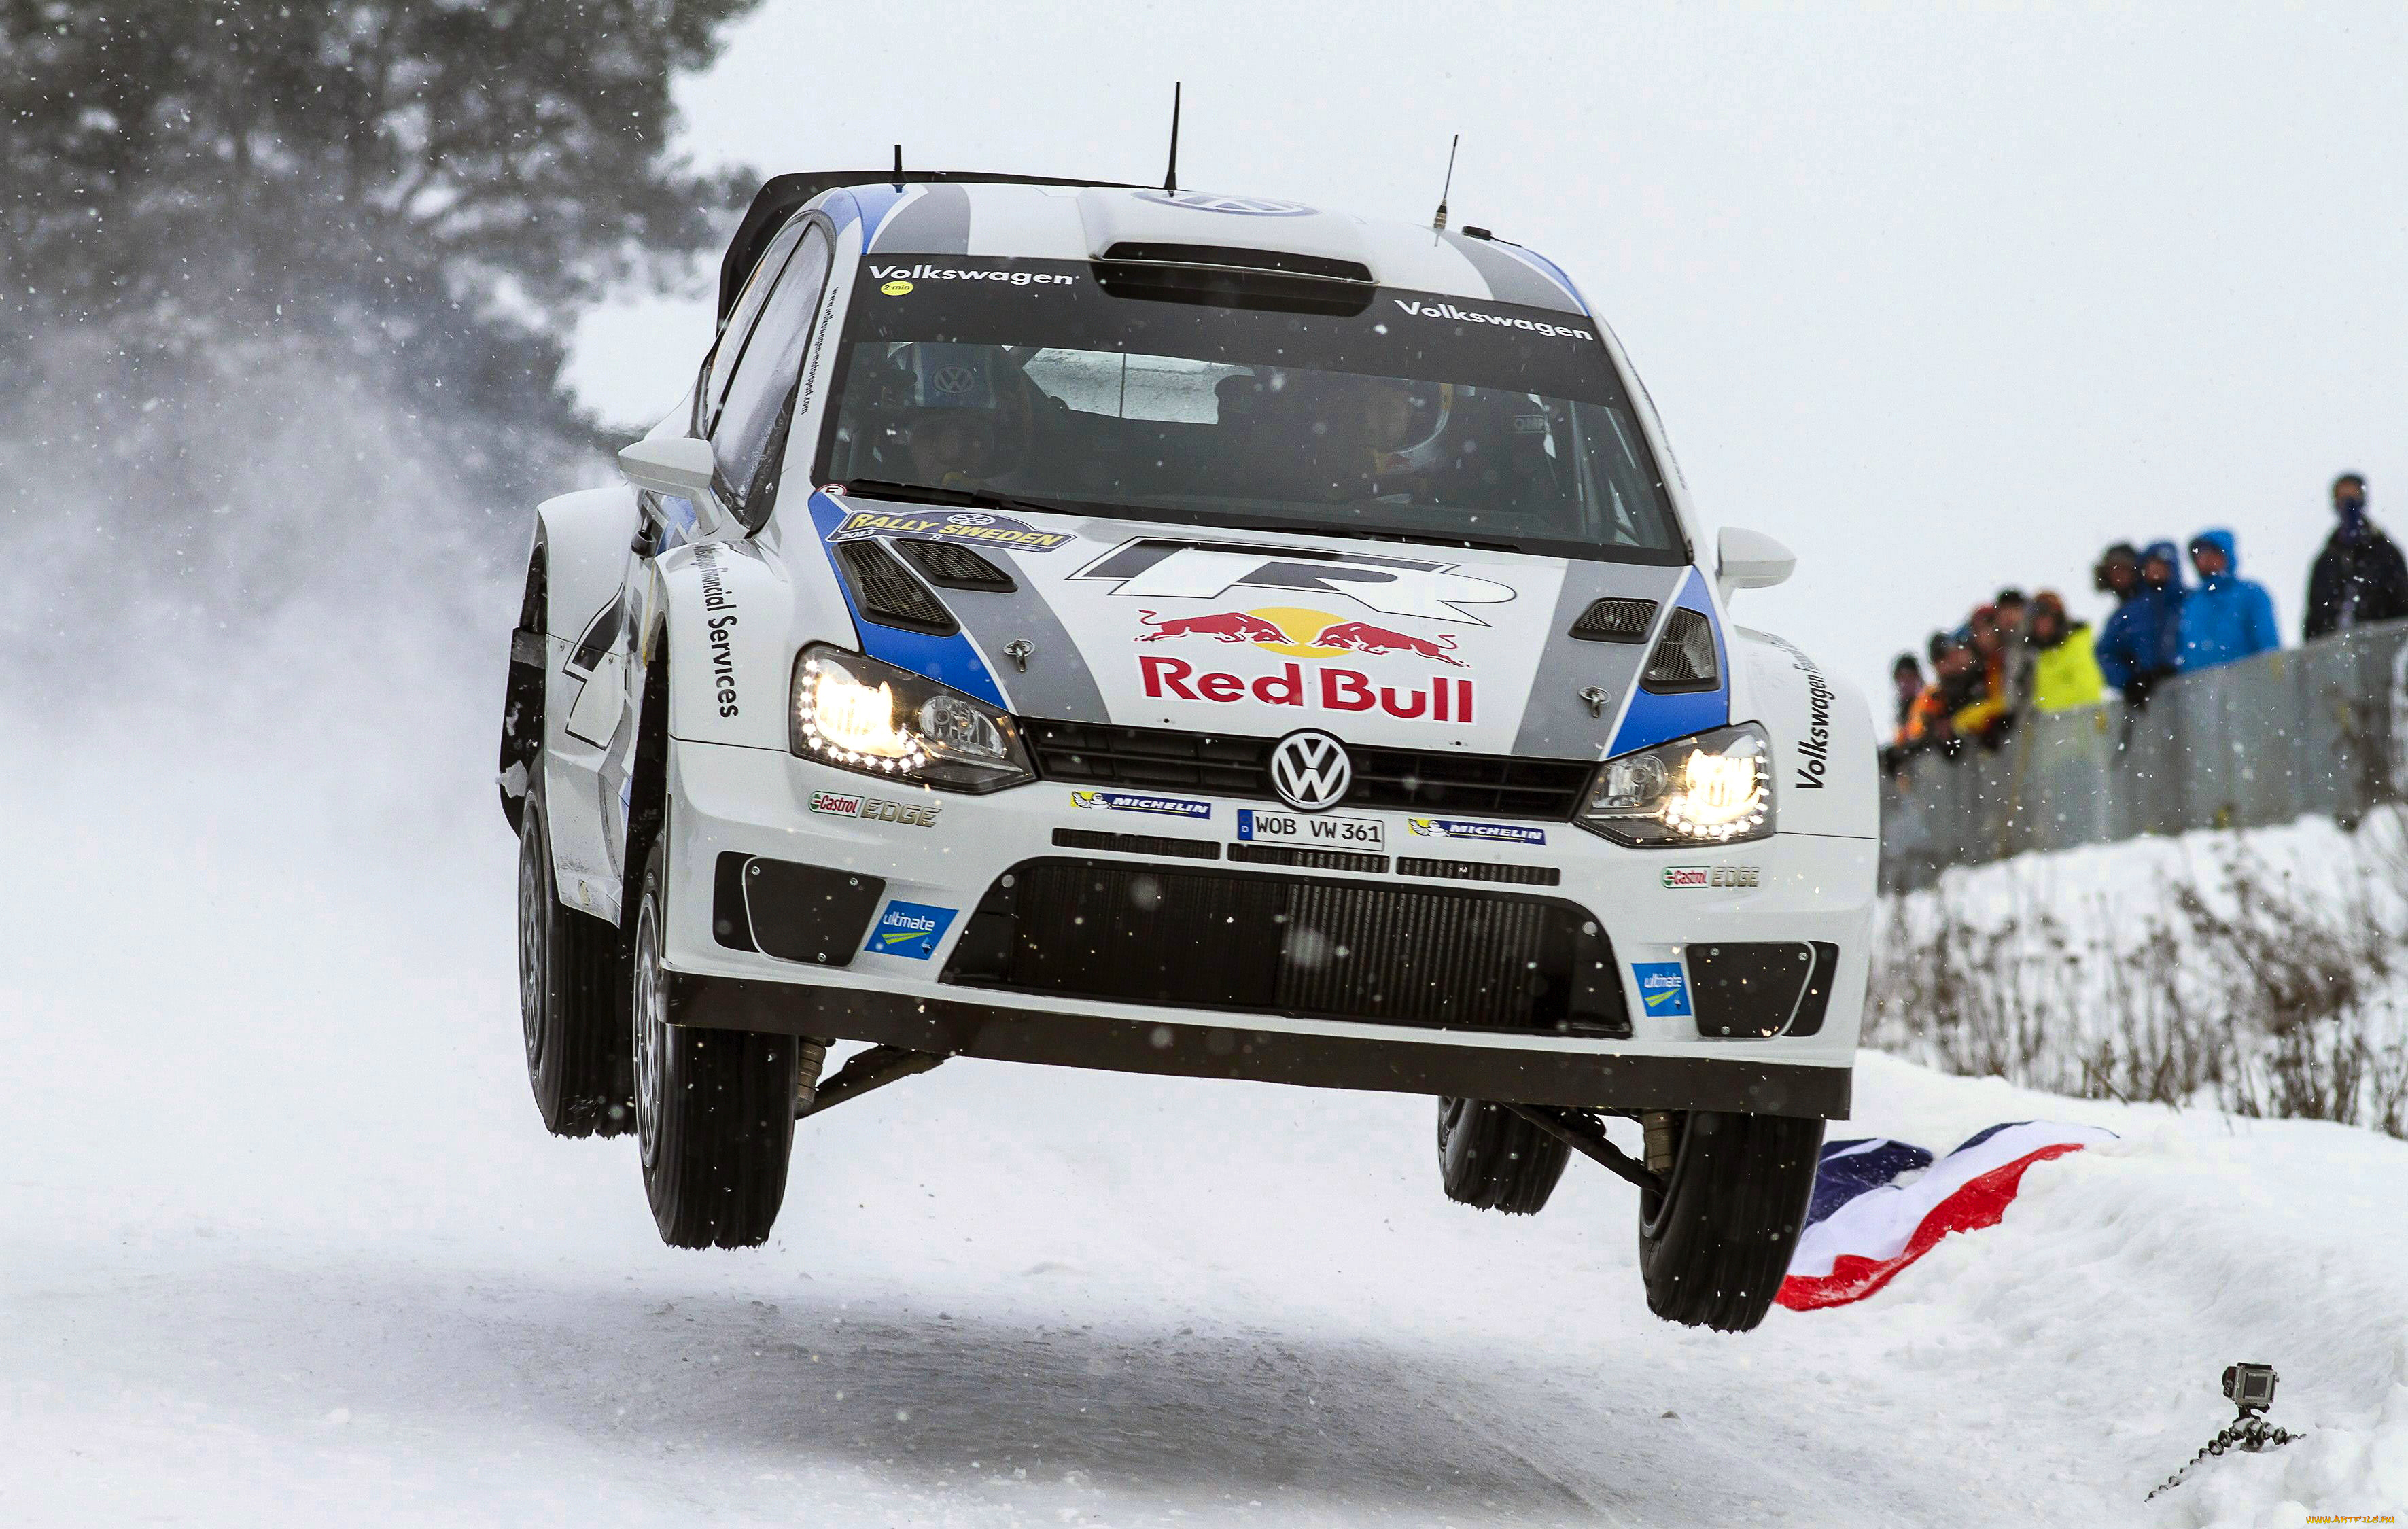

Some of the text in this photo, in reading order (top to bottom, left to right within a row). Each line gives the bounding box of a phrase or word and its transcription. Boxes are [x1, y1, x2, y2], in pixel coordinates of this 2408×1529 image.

[869, 265, 1073, 285] Volkswagen
[1393, 299, 1594, 340] Volkswagen
[847, 513, 1066, 546] RALLY SWEDEN
[708, 616, 739, 718] Services
[1138, 656, 1474, 724] Red Bull
[1795, 673, 1836, 789] Volkswagen
[820, 794, 943, 828] Castrol EDGE
[1111, 797, 1209, 813] MICHELIN
[1255, 816, 1382, 843] WOB VW 361
[1449, 824, 1543, 840] MICHELIN
[1711, 866, 1761, 887] EDGE
[883, 911, 936, 932] ultimate
